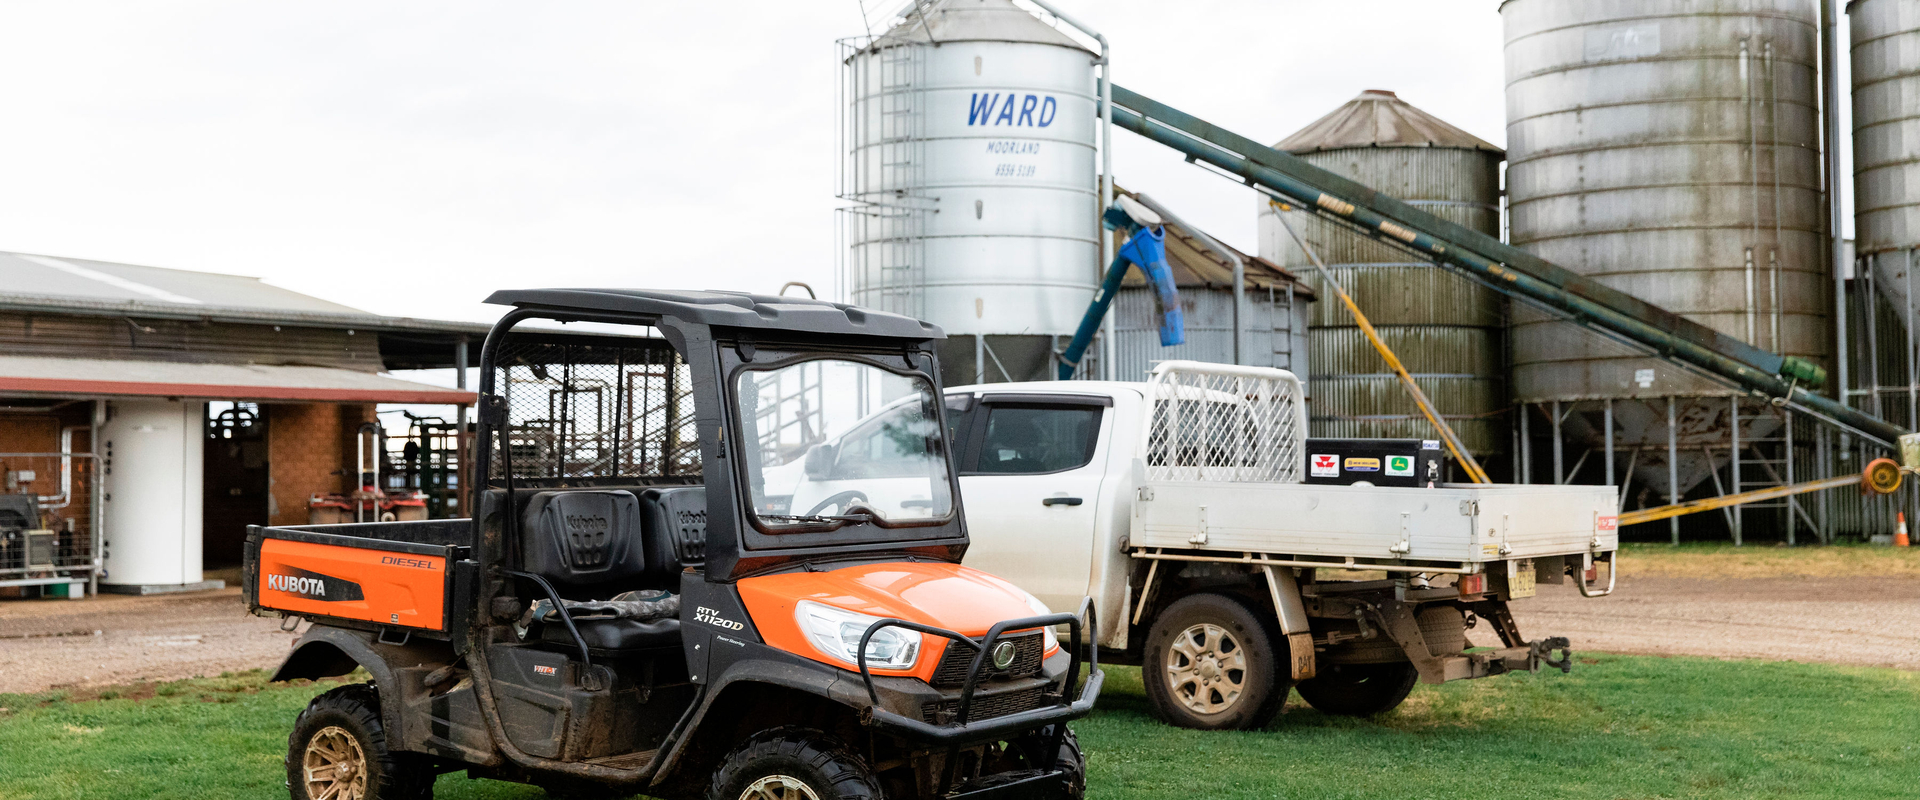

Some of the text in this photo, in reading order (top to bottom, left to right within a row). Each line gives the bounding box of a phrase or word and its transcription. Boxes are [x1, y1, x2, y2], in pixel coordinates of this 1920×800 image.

[967, 93, 1057, 127] WARD
[986, 141, 1039, 154] MOORLAND
[566, 514, 608, 530] Kubota
[676, 510, 707, 525] Kubot
[381, 556, 437, 570] DIESEL
[268, 573, 326, 596] KUBOTA
[696, 606, 720, 616] RTV
[693, 612, 744, 631] X1120D
